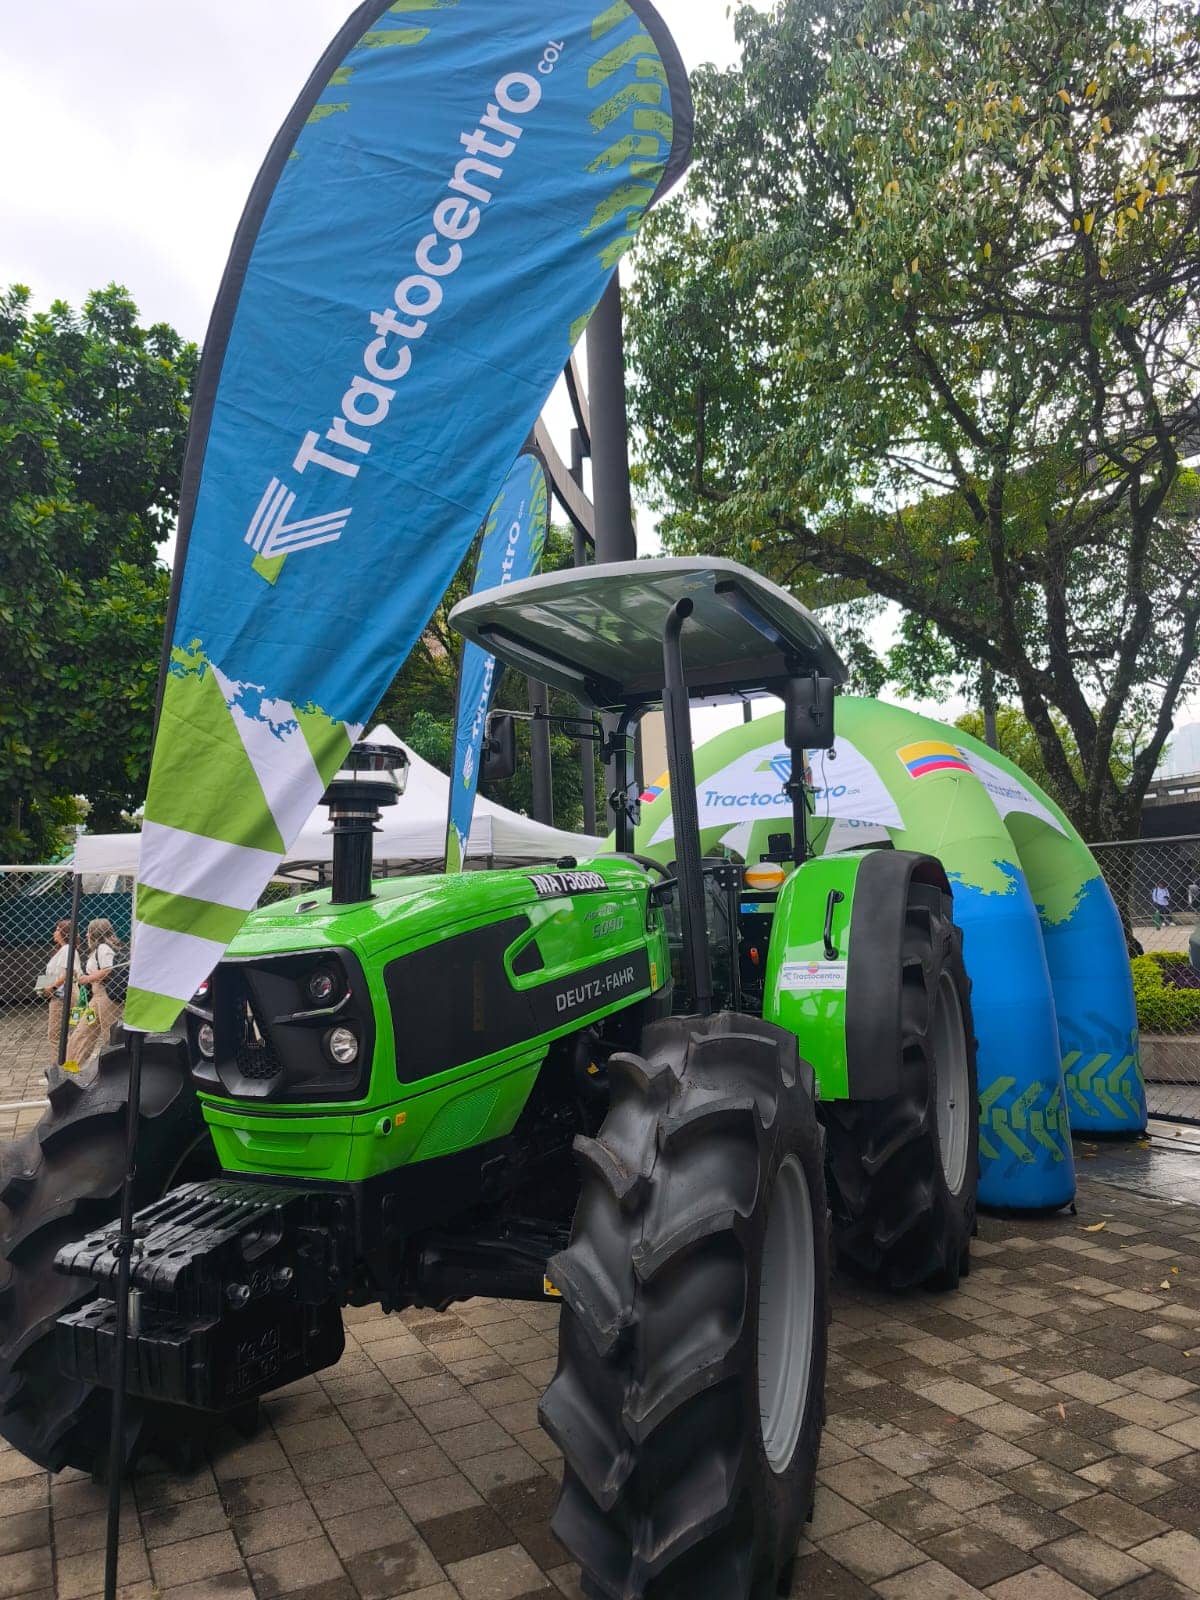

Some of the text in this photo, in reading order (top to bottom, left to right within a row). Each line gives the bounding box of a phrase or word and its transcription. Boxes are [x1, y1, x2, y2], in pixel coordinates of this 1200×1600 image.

[292, 40, 564, 478] Tractocentro COL
[556, 966, 635, 1012] DEUTZ-FAHR
